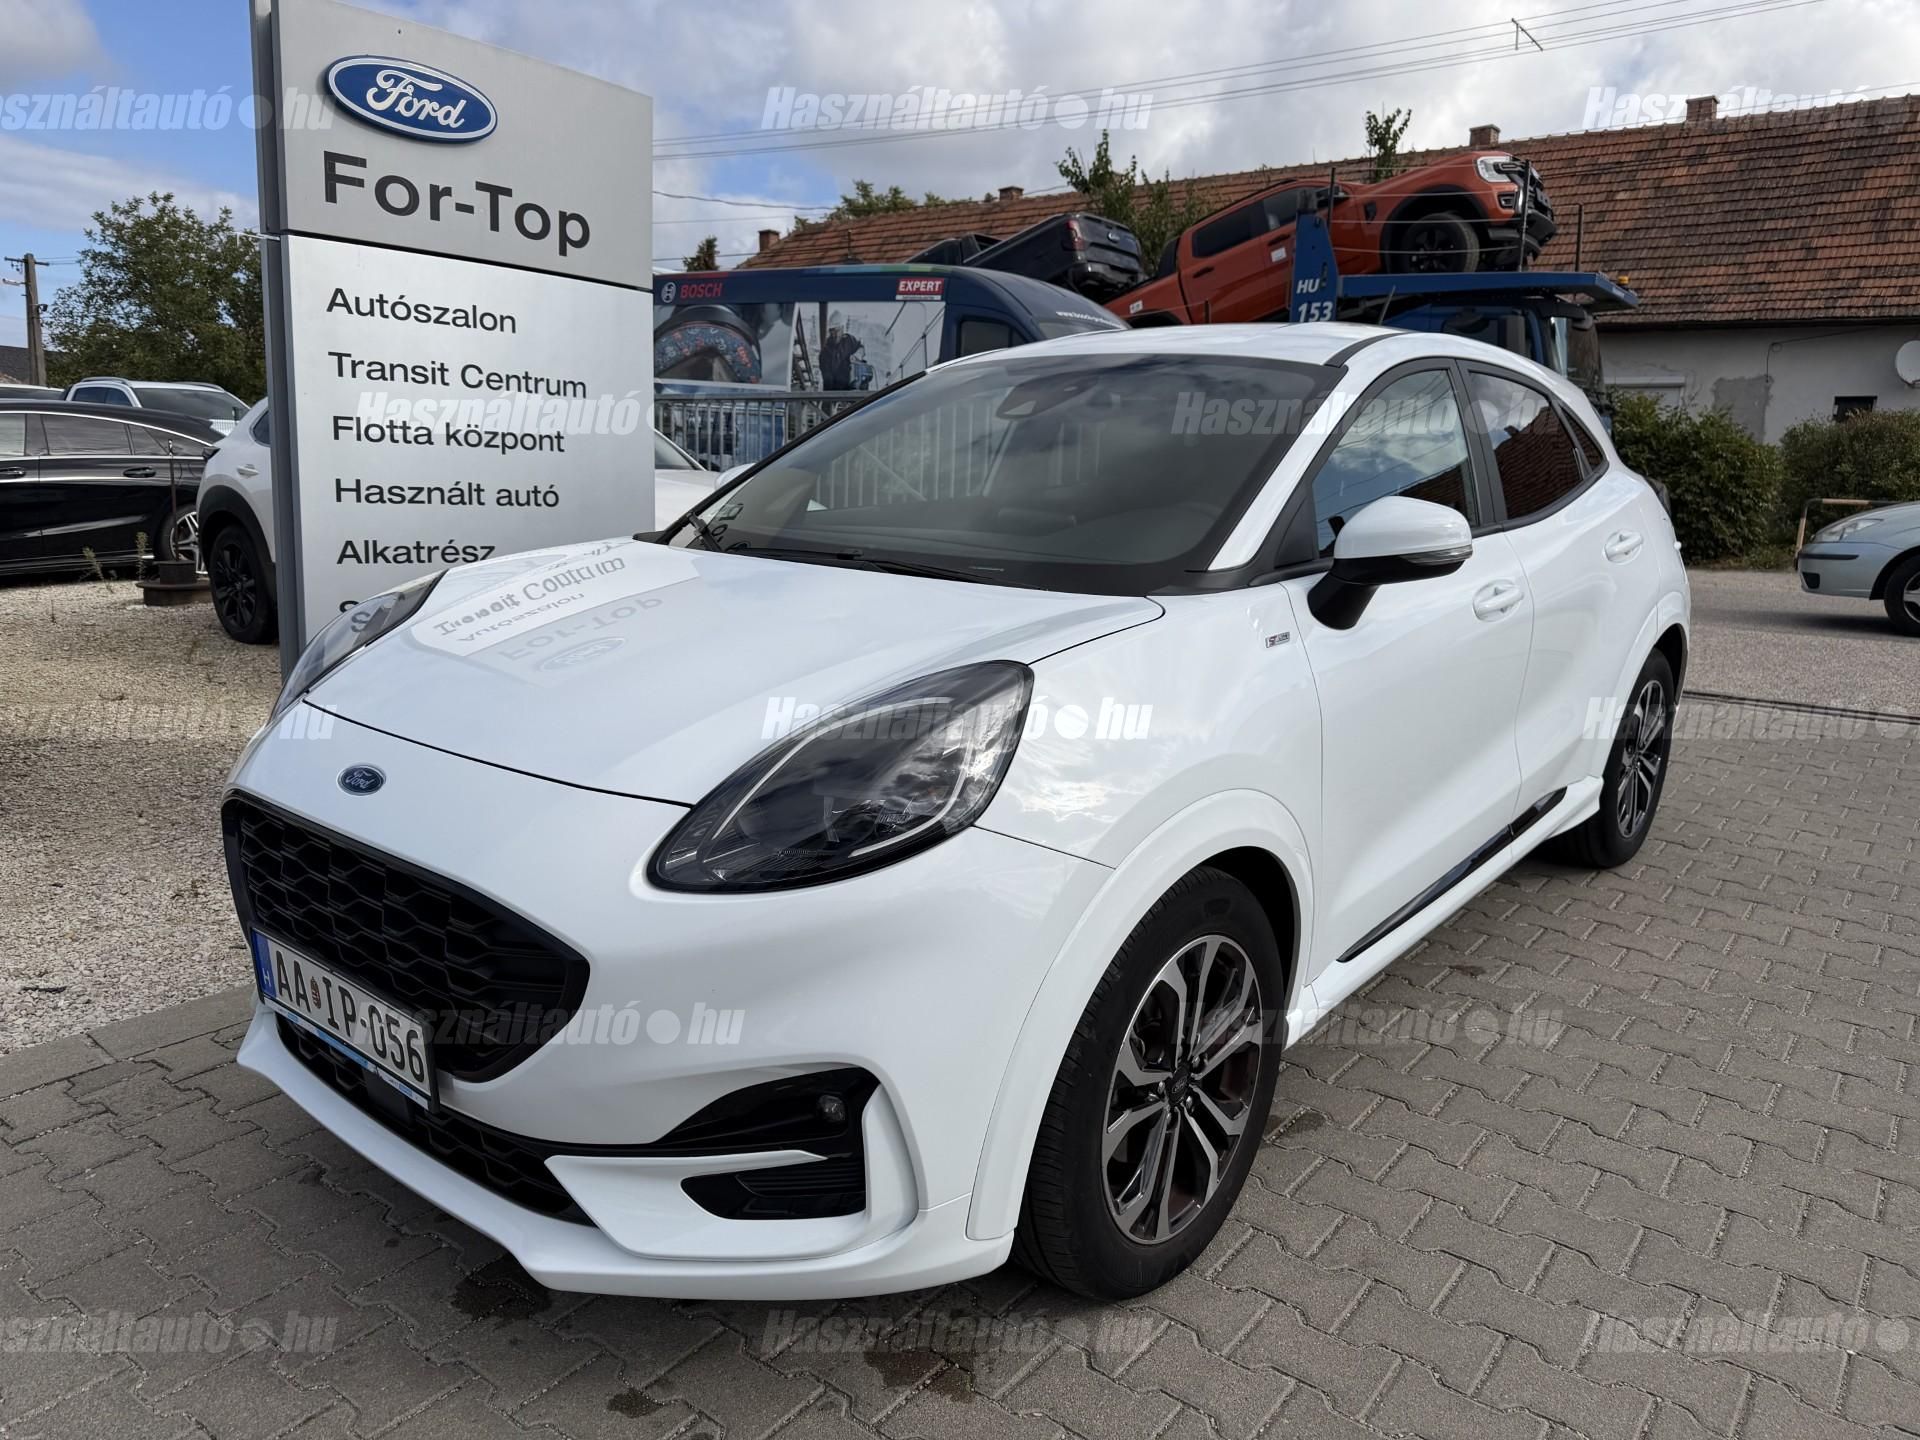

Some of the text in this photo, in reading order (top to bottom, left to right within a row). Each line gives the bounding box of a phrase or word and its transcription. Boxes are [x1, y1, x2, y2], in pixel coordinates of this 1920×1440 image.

[366, 69, 466, 128] Ford
[324, 150, 590, 257] For-Top
[680, 283, 722, 298] BOSCH
[899, 280, 941, 291] EXPERT
[1296, 279, 1320, 294] HU
[326, 287, 517, 334] Autószalon
[1298, 301, 1333, 323] 153
[328, 351, 587, 399] Transit Centrum
[333, 415, 565, 455] Flotta központ
[335, 478, 560, 507] Használt autó
[336, 539, 496, 565] Alkatrész
[346, 770, 375, 789] Ford
